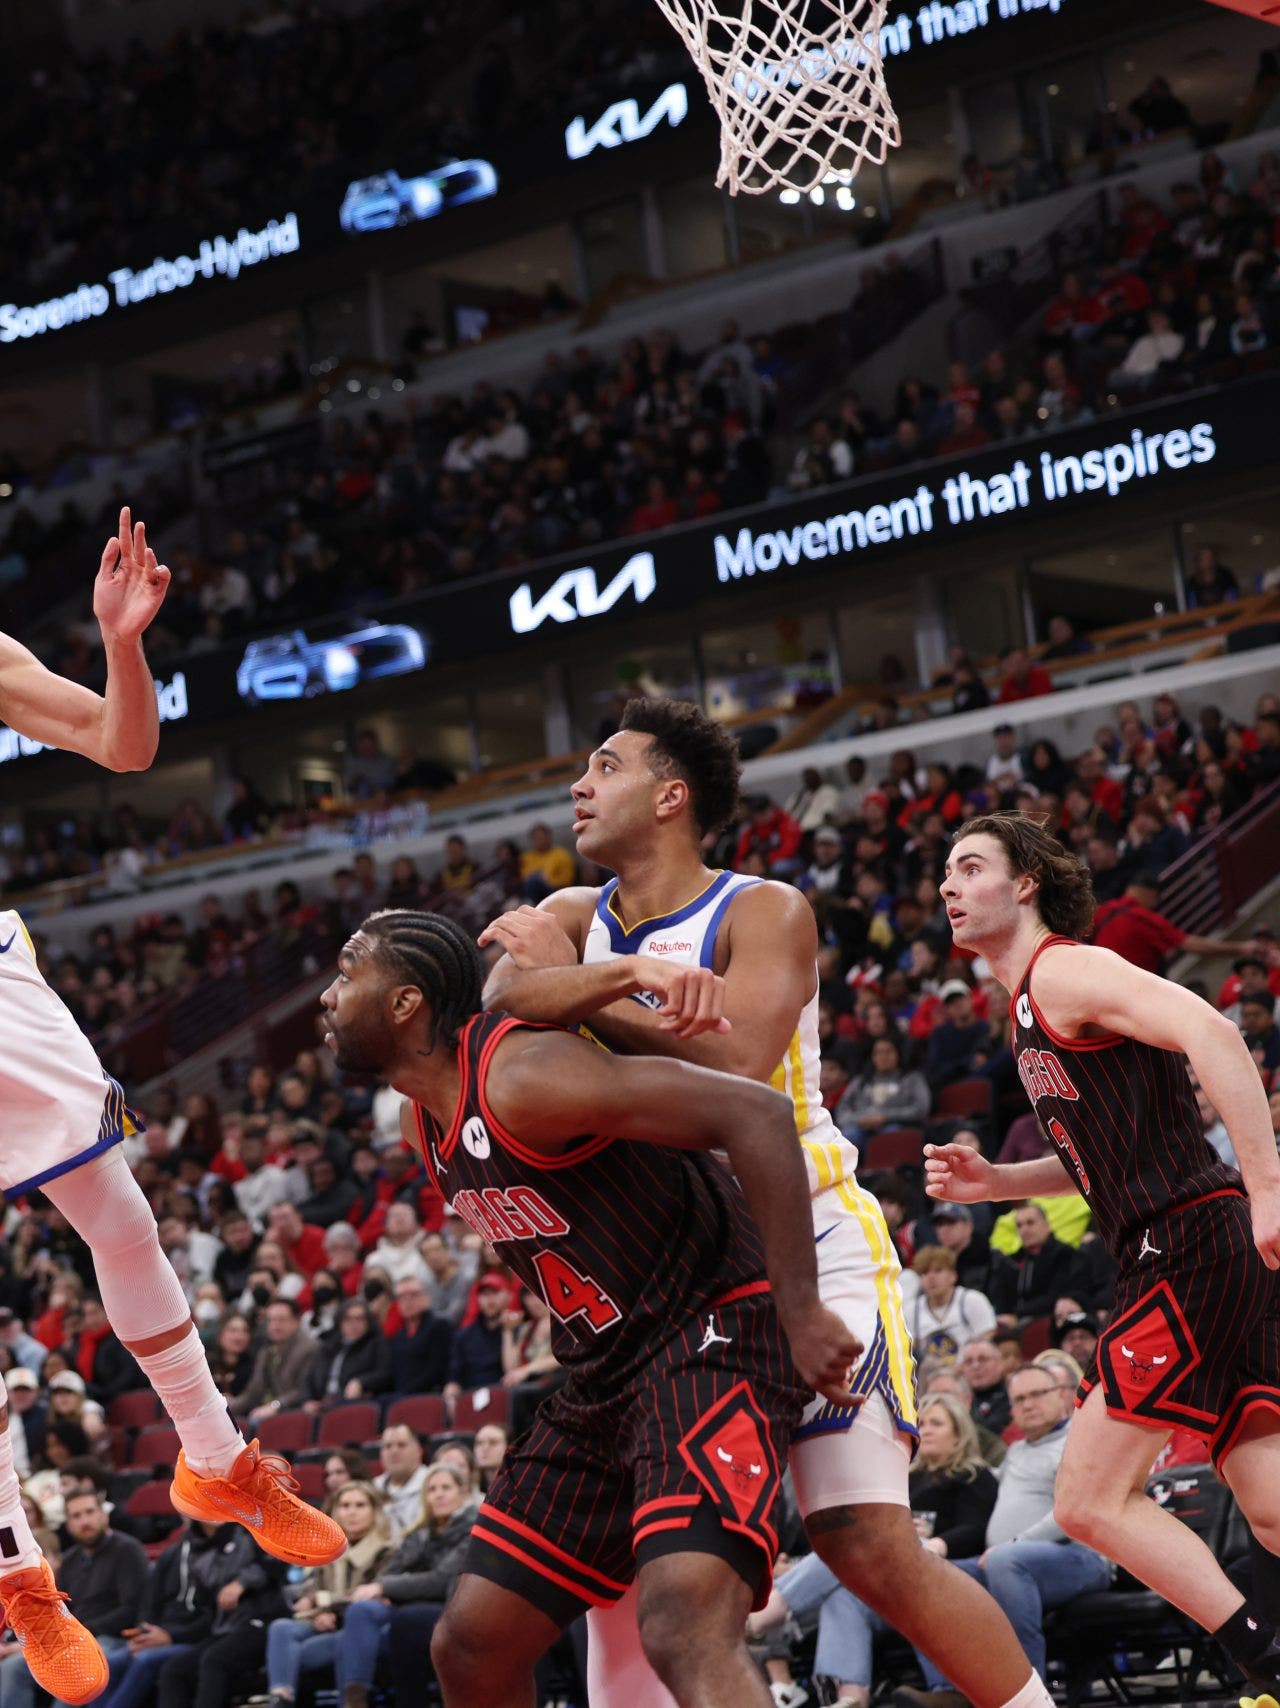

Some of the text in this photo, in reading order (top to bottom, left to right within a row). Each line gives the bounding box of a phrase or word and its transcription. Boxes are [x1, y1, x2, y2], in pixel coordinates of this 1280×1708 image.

[917, 0, 989, 45] that
[109, 213, 300, 306] Turbo-Hybrid
[713, 422, 1217, 583] Movement that inspires
[648, 941, 692, 955] Rakuten
[531, 1248, 623, 1335] 4
